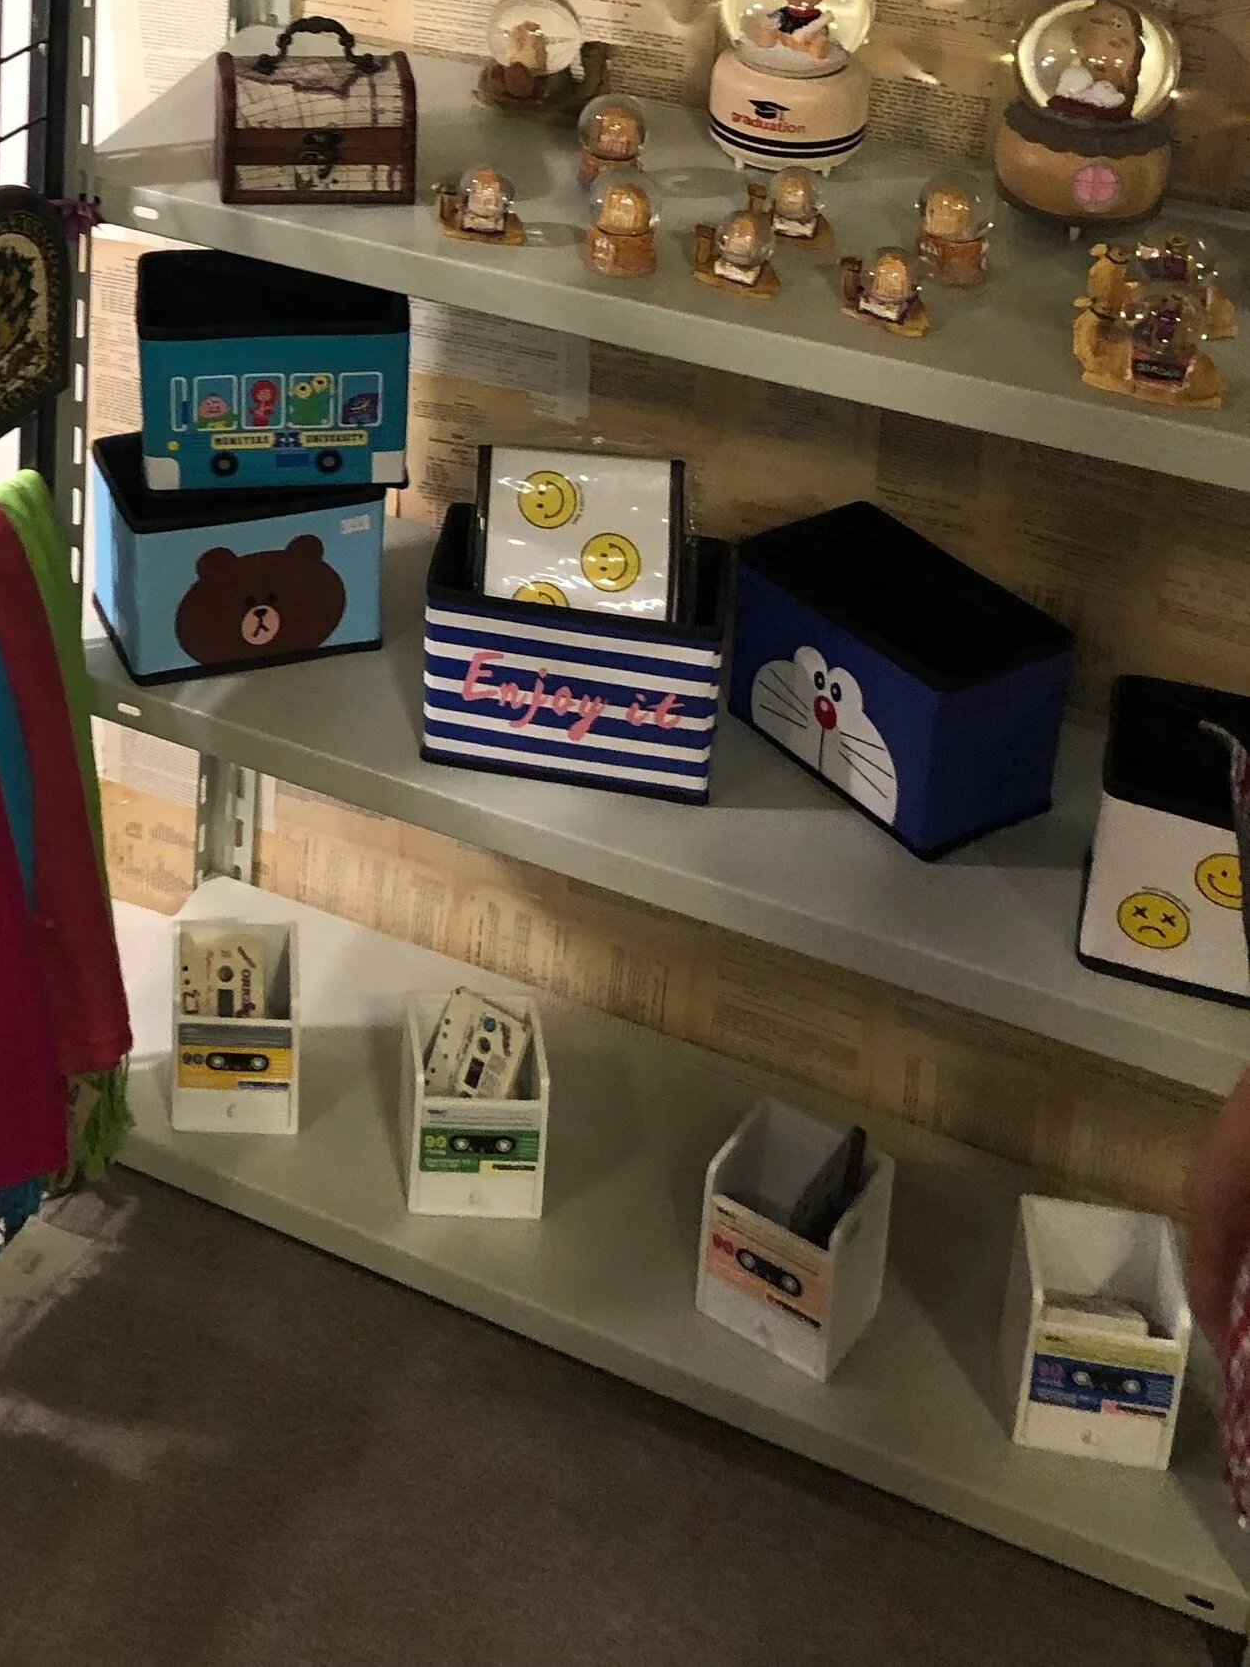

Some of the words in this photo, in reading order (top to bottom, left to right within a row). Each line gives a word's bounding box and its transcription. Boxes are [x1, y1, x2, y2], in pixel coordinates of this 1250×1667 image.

[731, 111, 806, 133] graduation
[461, 651, 607, 742] Enjoy
[624, 692, 686, 730] it
